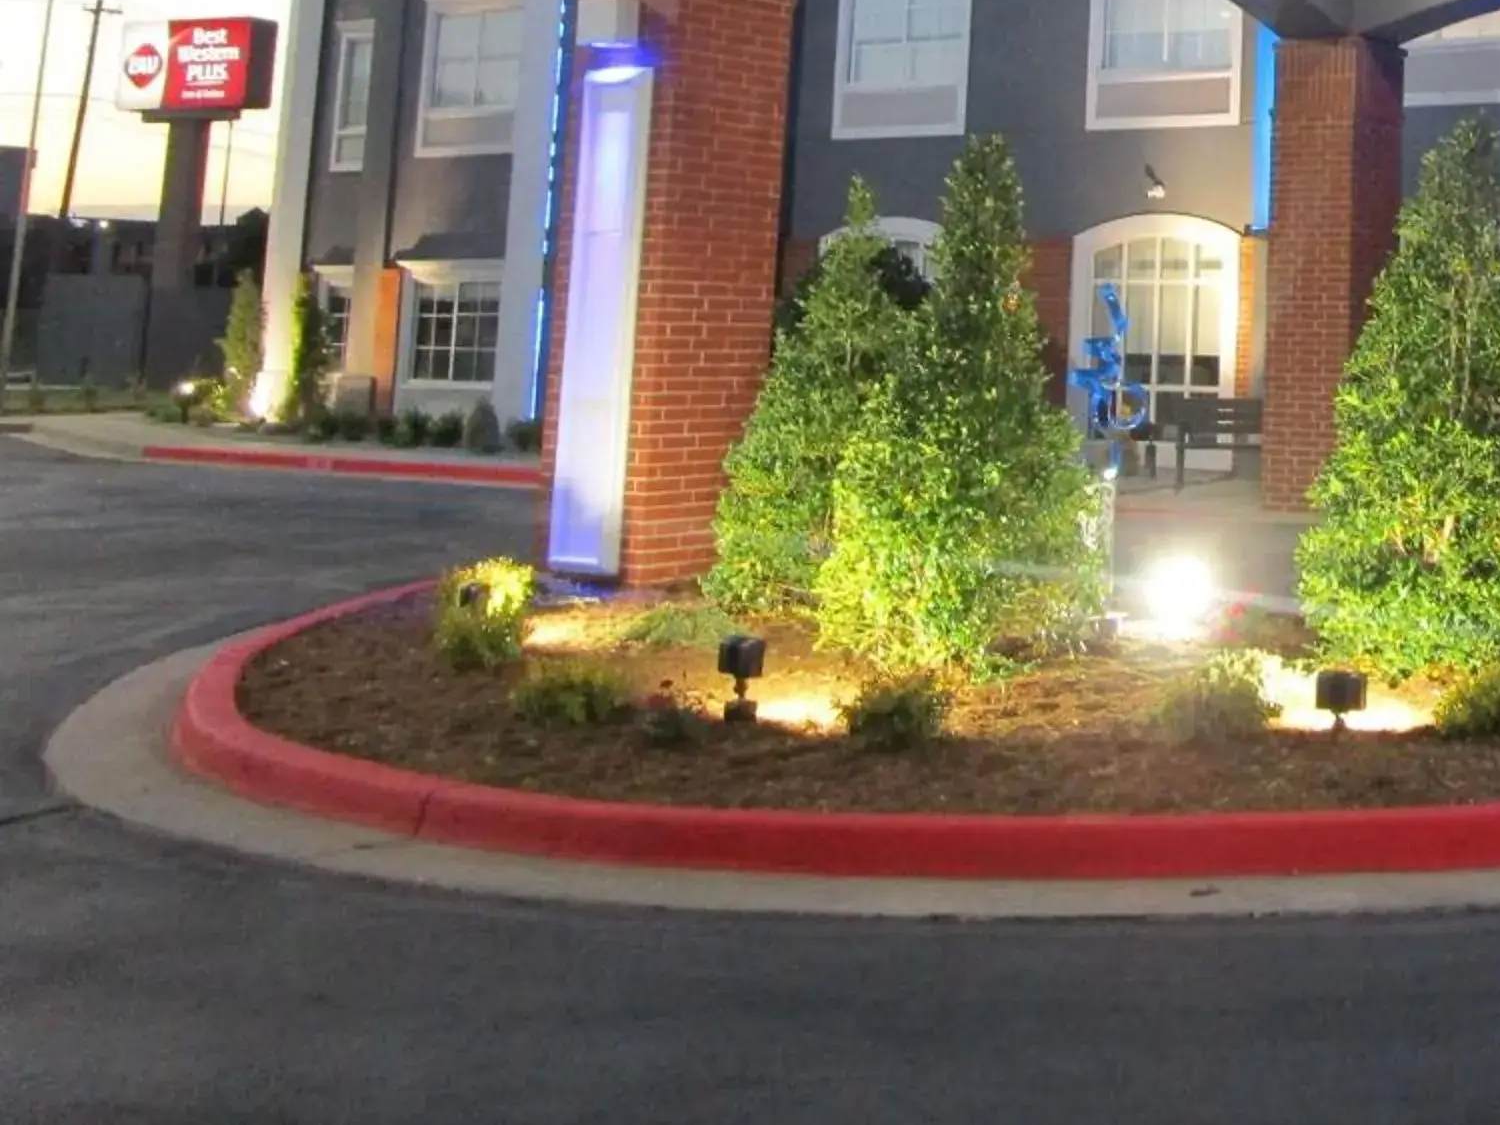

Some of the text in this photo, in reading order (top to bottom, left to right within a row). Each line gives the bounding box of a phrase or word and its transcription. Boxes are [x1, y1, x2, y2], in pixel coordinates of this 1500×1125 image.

[192, 27, 228, 44] Best
[177, 46, 240, 63] Western
[186, 63, 229, 82] PLUS
